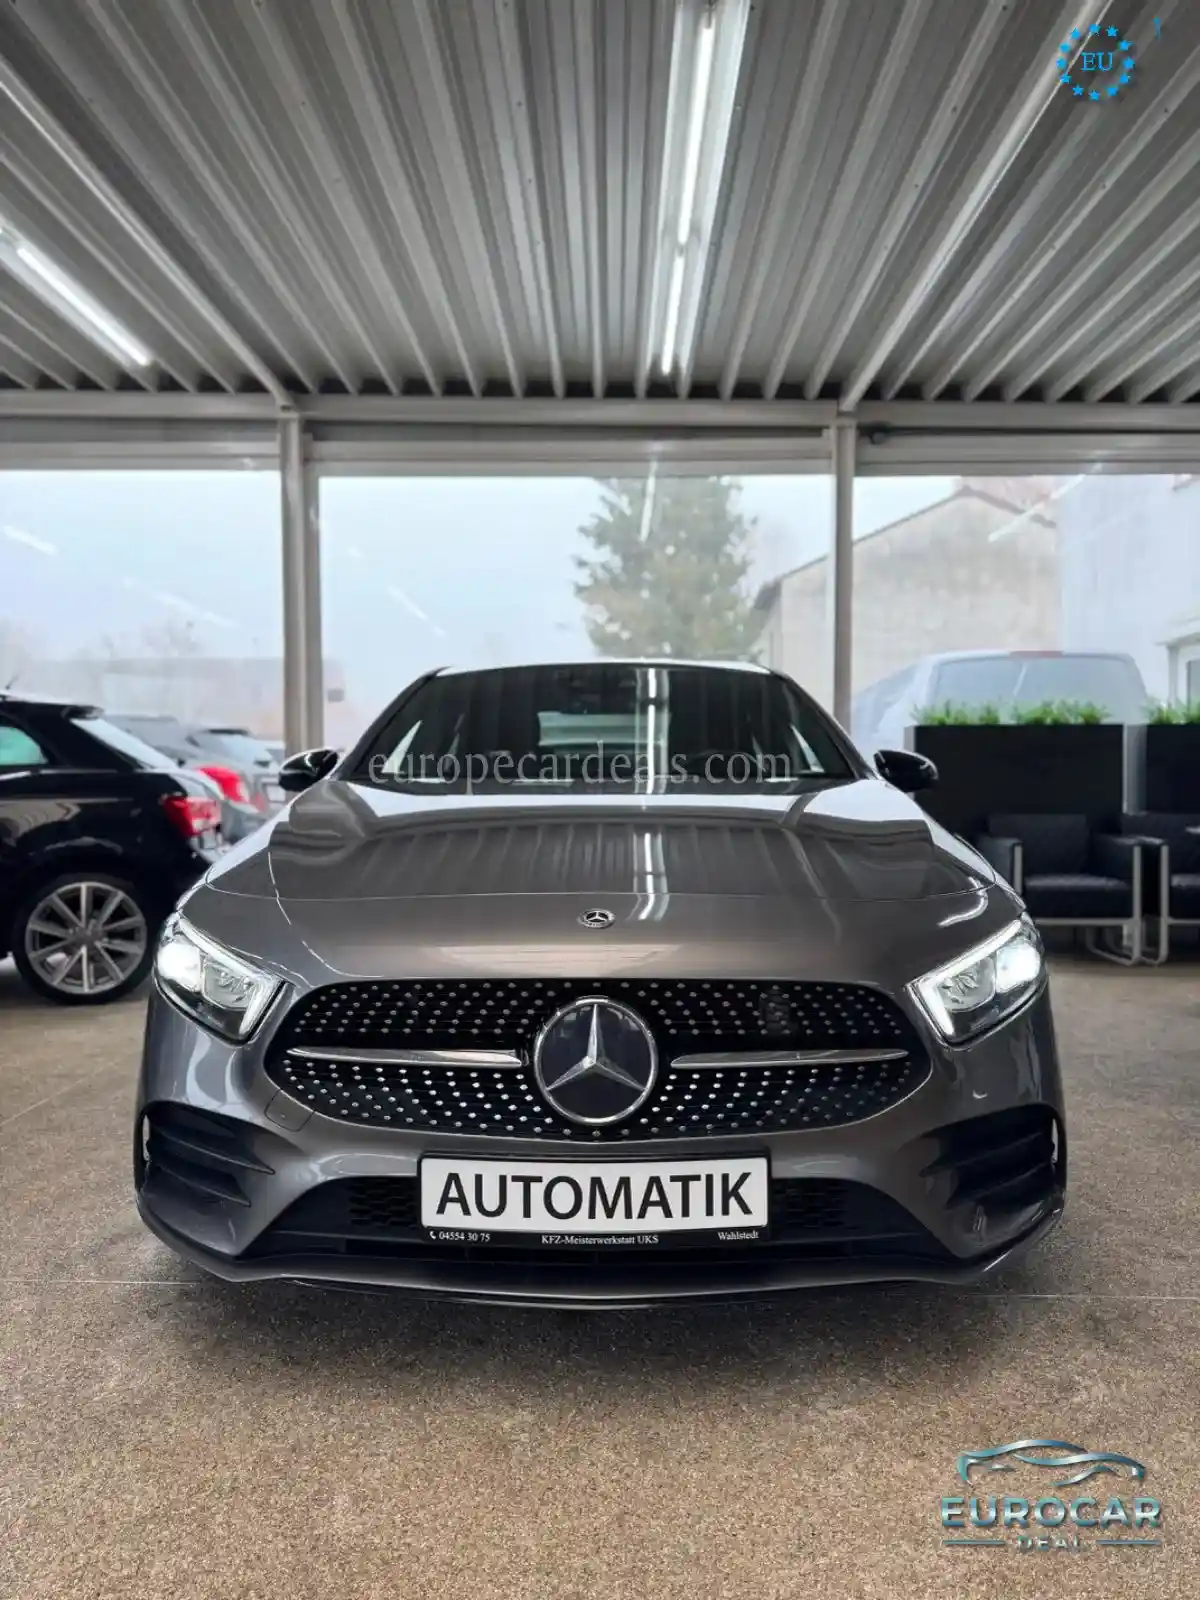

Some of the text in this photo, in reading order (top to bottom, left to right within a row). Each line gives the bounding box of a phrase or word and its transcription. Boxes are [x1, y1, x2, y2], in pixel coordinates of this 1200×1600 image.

[436, 1171, 754, 1220] AUTOMATIK
[439, 1231, 465, 1241] 04554
[480, 1232, 490, 1242] 75
[541, 1234, 660, 1245] KFZ-Meisterwerkstatt UKS
[717, 1230, 759, 1241] Wahlstedt
